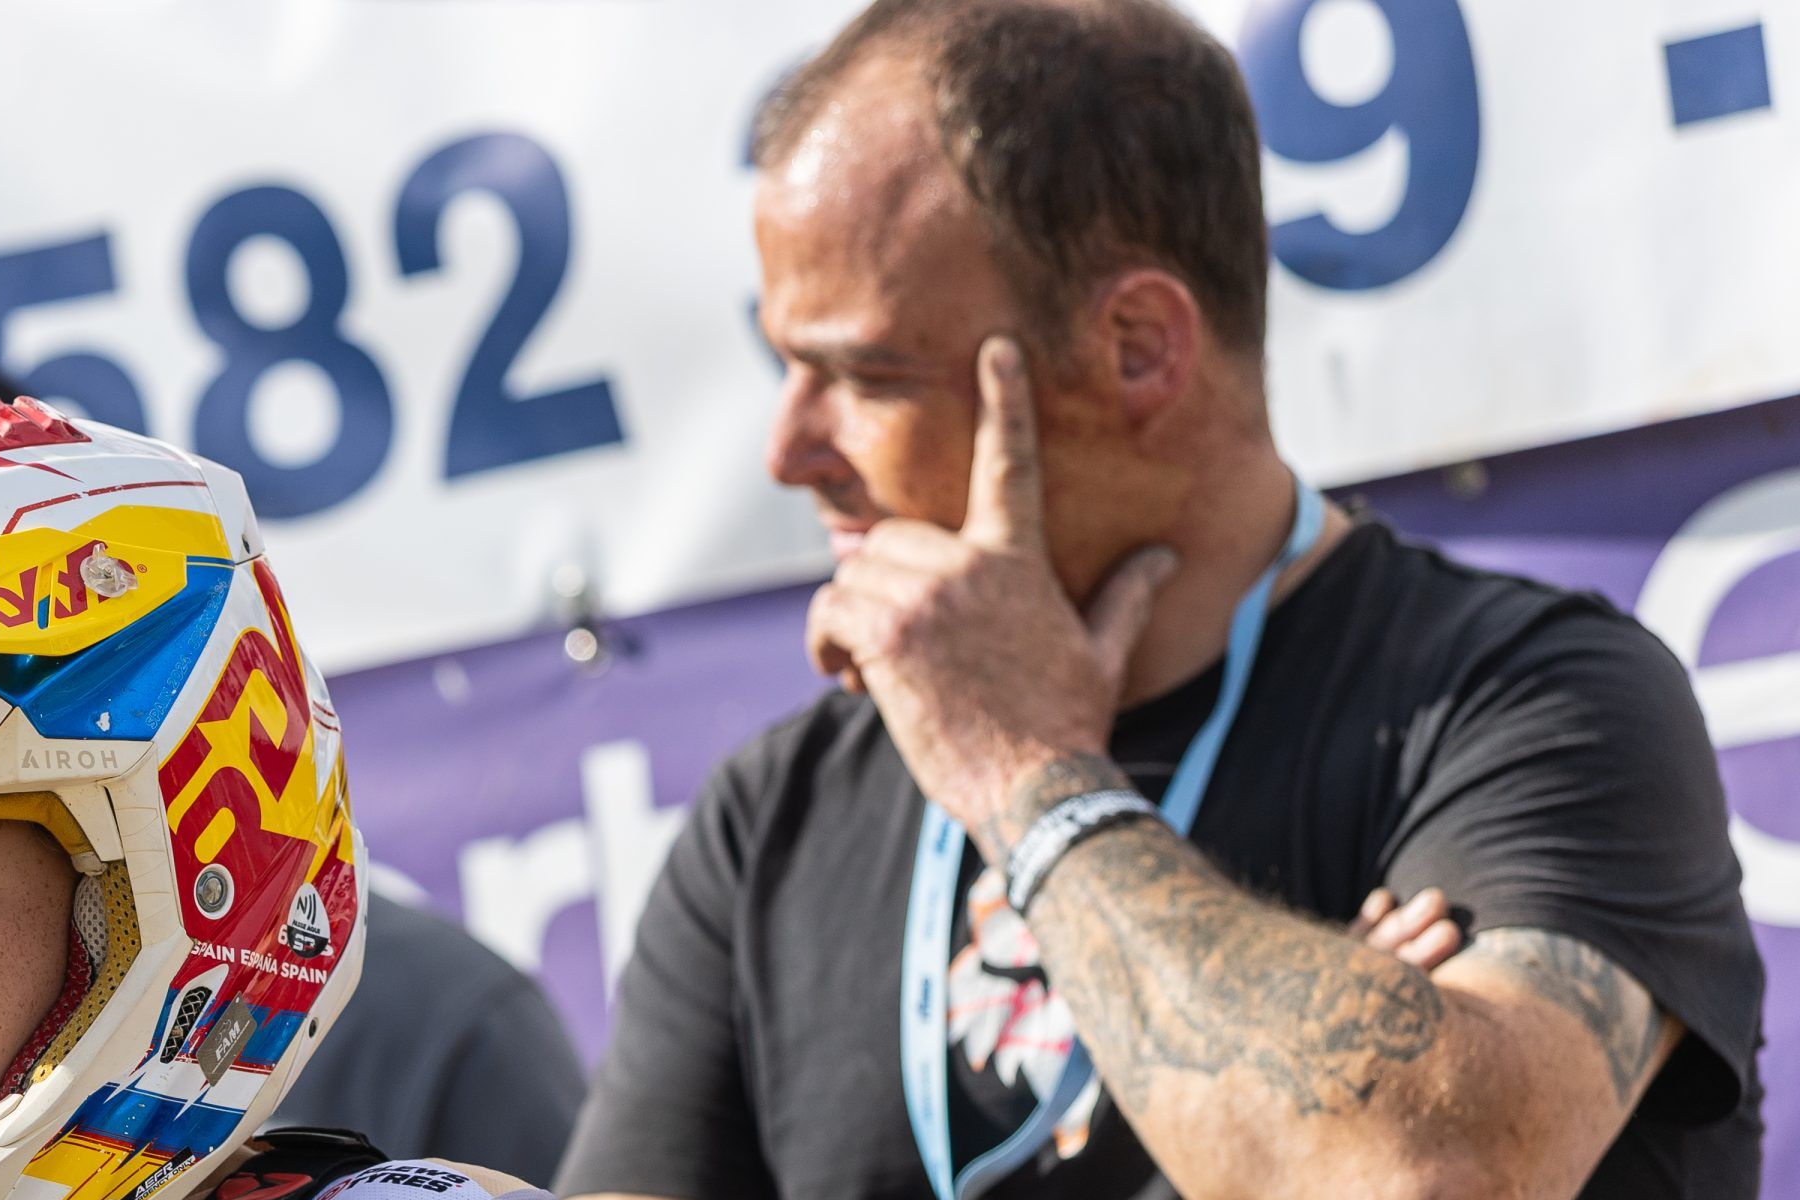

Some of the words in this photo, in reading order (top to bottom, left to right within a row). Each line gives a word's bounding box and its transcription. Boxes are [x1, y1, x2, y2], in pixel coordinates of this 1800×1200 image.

[166, 653, 193, 690] 2024
[21, 748, 119, 771] AIROH
[191, 941, 235, 963] SPAIN
[240, 949, 279, 976] ESPAÑA
[281, 962, 329, 985] SPAIN
[215, 1020, 241, 1062] FAM
[135, 1161, 174, 1198] AEFR
[172, 1157, 194, 1176] ONLY
